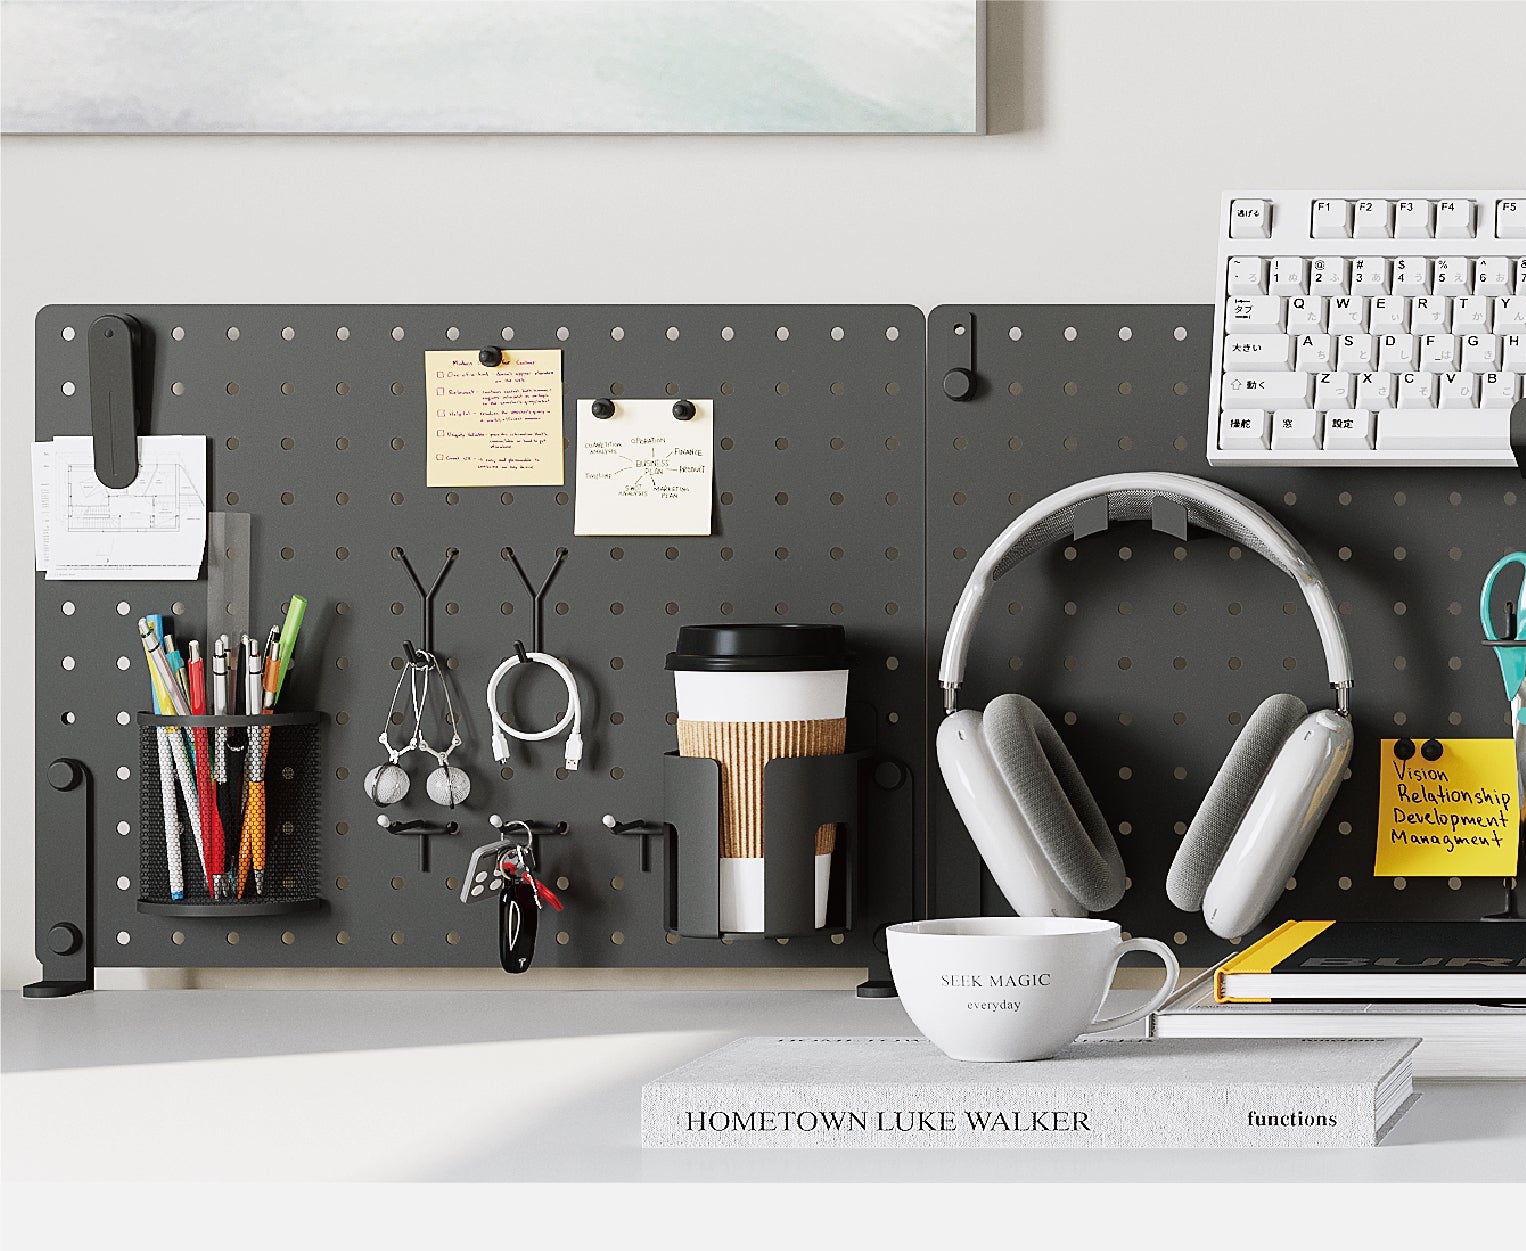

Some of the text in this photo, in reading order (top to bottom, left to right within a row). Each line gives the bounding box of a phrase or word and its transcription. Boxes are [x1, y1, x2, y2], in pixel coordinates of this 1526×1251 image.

[1319, 203, 1329, 211] F1
[1360, 203, 1372, 211] F2
[1401, 203, 1413, 211] F3
[1442, 203, 1454, 211] F4
[1503, 203, 1516, 211] F5
[1235, 305, 1253, 313] タブ
[1294, 299, 1304, 309] Q
[1337, 299, 1349, 308] W
[1377, 299, 1385, 308] E
[1418, 299, 1427, 308] R
[1460, 299, 1468, 308] T
[1501, 299, 1510, 308] Y
[1303, 336, 1313, 345] A
[1345, 336, 1353, 346] S
[1386, 336, 1395, 345] D
[1427, 336, 1435, 345] F
[1468, 336, 1478, 346] G
[1510, 336, 1518, 345] H
[1233, 344, 1261, 352] 大きい
[1321, 374, 1330, 383] Z
[1363, 374, 1372, 383] X
[1405, 374, 1414, 383] C
[1446, 374, 1455, 383] V
[1488, 374, 1496, 383] B
[1247, 381, 1264, 389] 動く
[1332, 419, 1353, 428] 設定
[1393, 759, 1448, 782] Vision
[1398, 784, 1511, 811] Relationship
[1393, 808, 1509, 832] Development
[1391, 829, 1504, 853] Managment
[942, 973, 1052, 988] SEEK MAGIC
[967, 1000, 1021, 1012] everyday
[685, 1106, 1337, 1136] HOMETOWN LUKE WALKER functions
